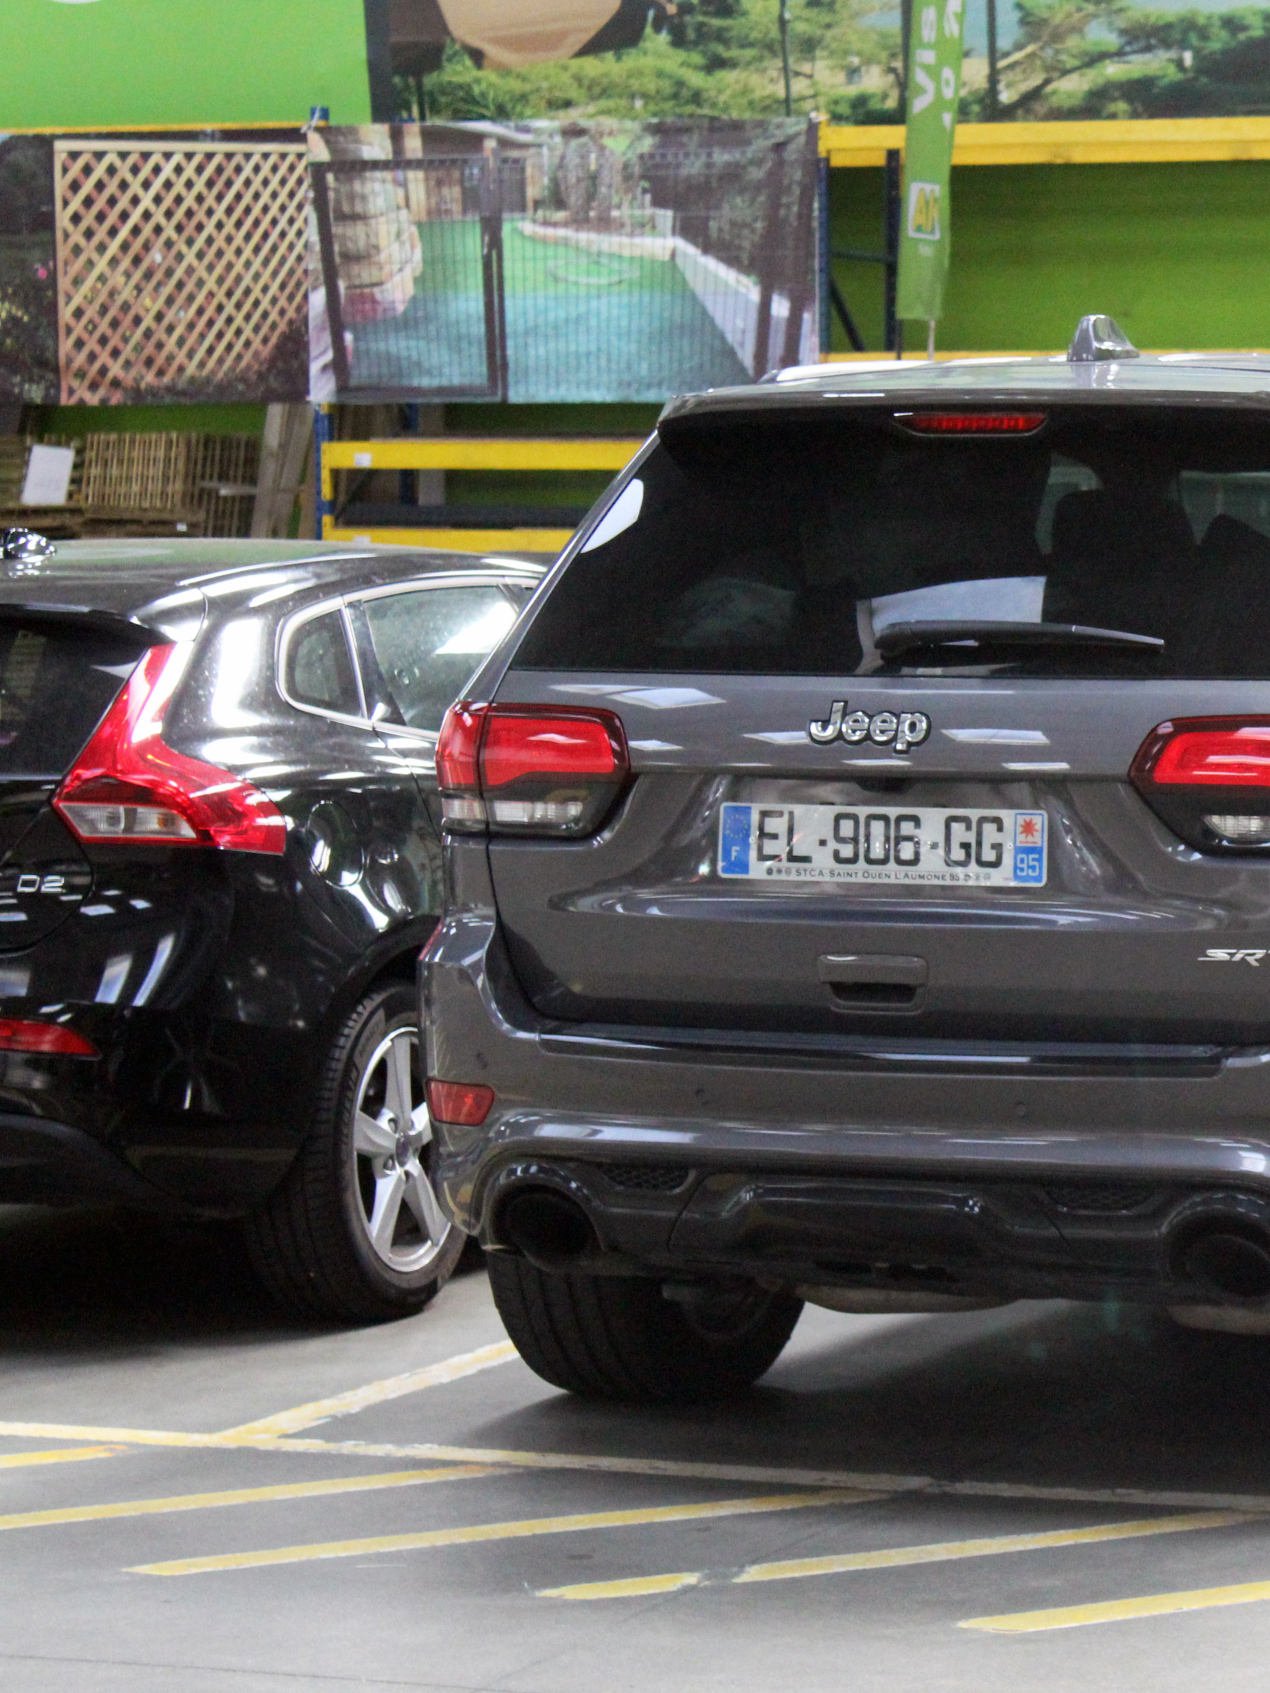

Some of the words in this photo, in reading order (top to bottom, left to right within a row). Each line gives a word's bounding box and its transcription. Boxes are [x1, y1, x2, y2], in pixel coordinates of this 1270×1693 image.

[808, 700, 930, 753] Jeep
[731, 846, 740, 862] F
[795, 868, 825, 878] STCA
[1016, 853, 1040, 877] 95
[17, 874, 65, 893] D2
